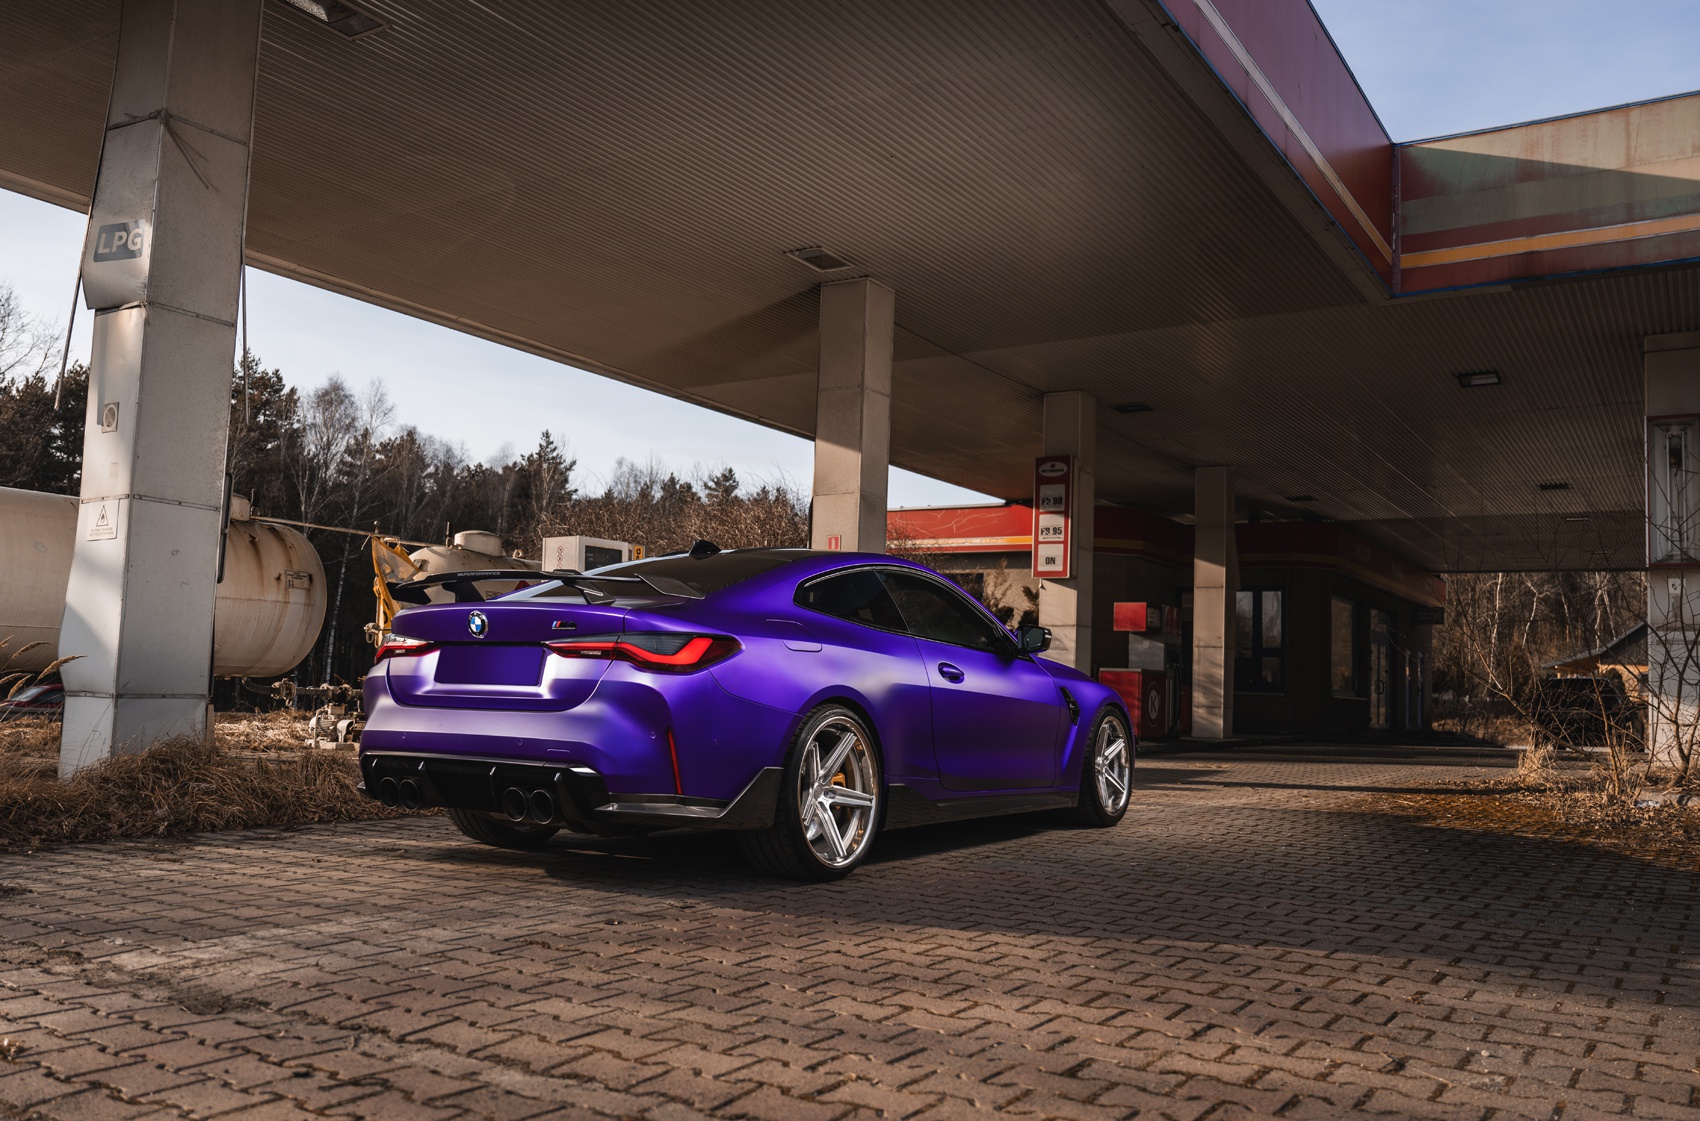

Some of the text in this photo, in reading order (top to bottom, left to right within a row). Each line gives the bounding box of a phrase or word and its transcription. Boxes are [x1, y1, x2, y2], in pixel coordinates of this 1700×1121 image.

[97, 227, 142, 254] LPG
[1052, 496, 1063, 505] 98
[1052, 526, 1063, 535] 95
[1045, 556, 1056, 565] ON
[1150, 695, 1157, 714] K
